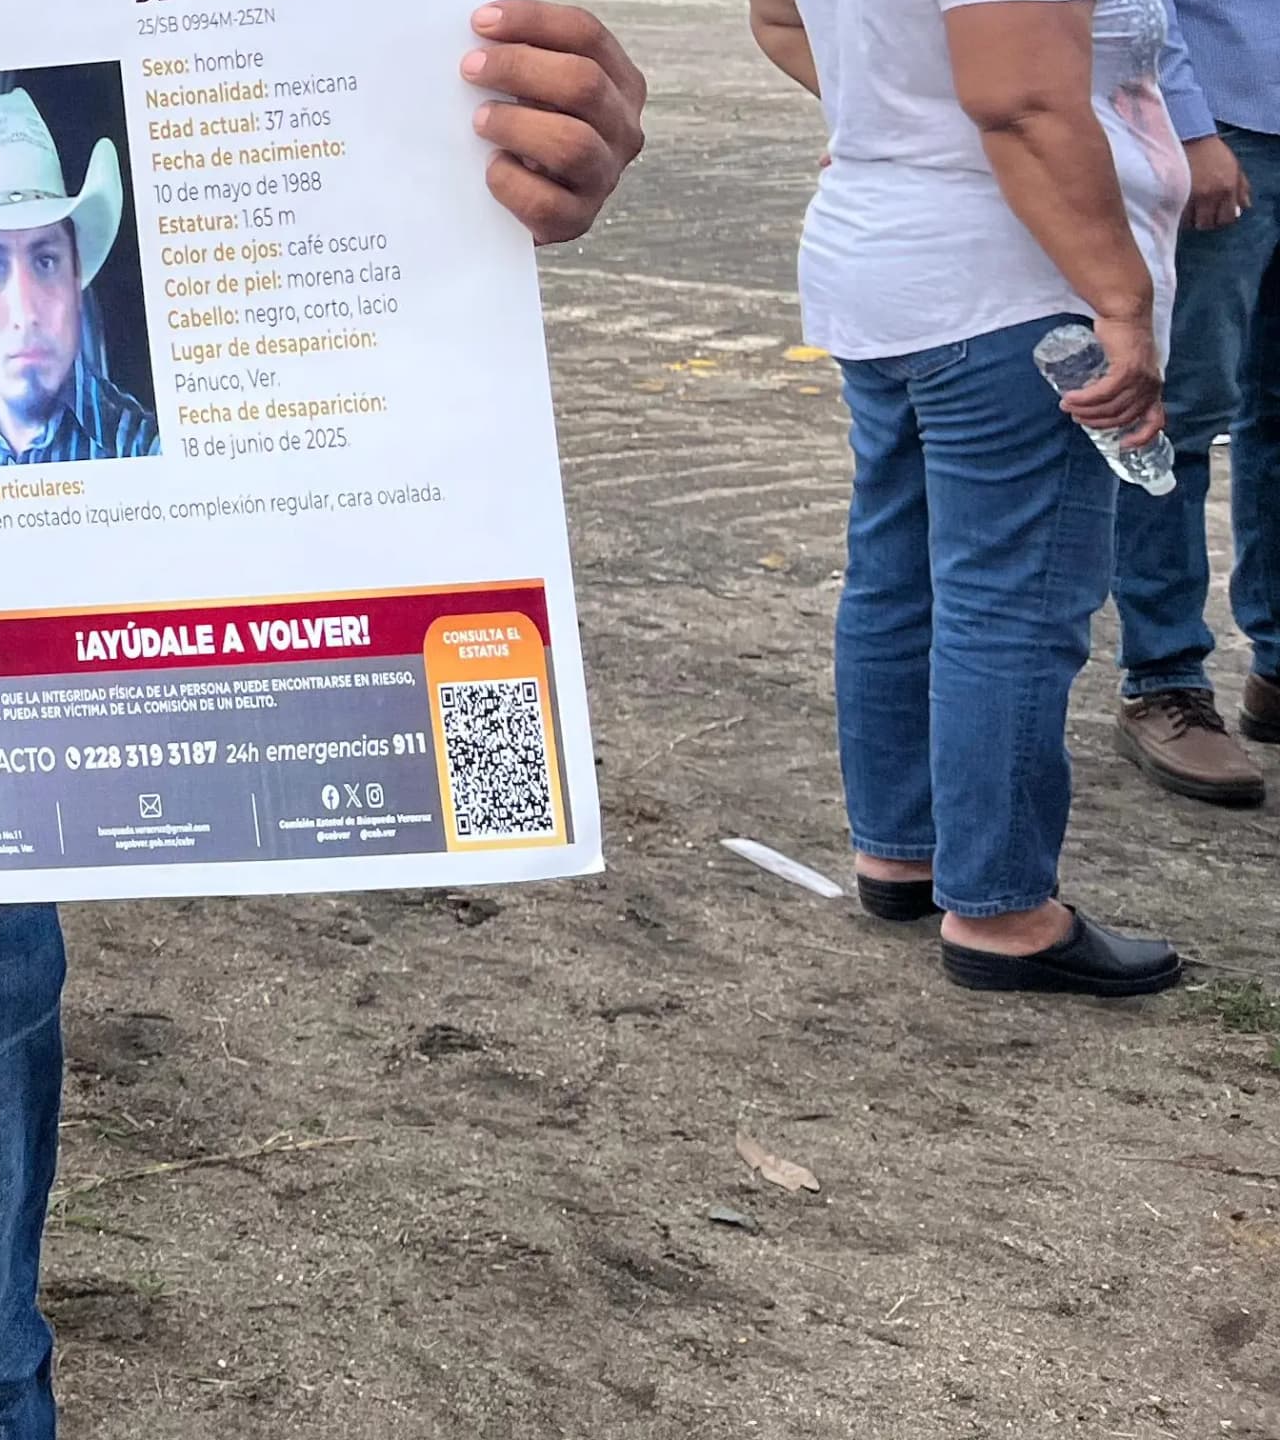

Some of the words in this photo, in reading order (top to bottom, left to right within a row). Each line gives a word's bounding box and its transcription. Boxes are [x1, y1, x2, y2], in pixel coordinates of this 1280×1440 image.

[137, 15, 178, 35] 25/SB
[182, 7, 275, 31] 0994M-25ZN
[142, 58, 189, 77] Sexo:
[193, 48, 264, 72] hombre
[145, 79, 268, 108] Nacionalidad:
[274, 74, 357, 97] mexicana
[148, 117, 193, 140] Edad
[199, 111, 260, 136] actual:
[264, 109, 284, 131] 37
[289, 107, 331, 128] años
[158, 214, 238, 234] Estatura:
[241, 206, 273, 228] 1.65
[278, 209, 295, 225] m
[171, 342, 222, 365] Lugar
[228, 337, 250, 357] de
[255, 327, 376, 357] desaparición:
[174, 372, 244, 393] Pánuco,
[247, 368, 280, 388] Ver.
[17, 506, 81, 528] costado
[86, 501, 165, 527] izquierdo,
[169, 495, 265, 520] complexión
[270, 491, 334, 515] regular,
[337, 490, 373, 508] cara
[377, 484, 445, 505] ovalada.
[75, 622, 215, 661] ¡AYÚDALE
[222, 622, 244, 653] A
[248, 614, 371, 651] VOLVER!
[442, 628, 504, 644] CONSULTA
[506, 627, 522, 640] EL
[458, 644, 510, 660] ESTATUS
[83, 745, 122, 769] 228
[125, 743, 163, 767] 319
[167, 740, 217, 765] 3187
[225, 742, 259, 763] 24h
[266, 734, 389, 762] emergencias
[392, 732, 426, 755] 911
